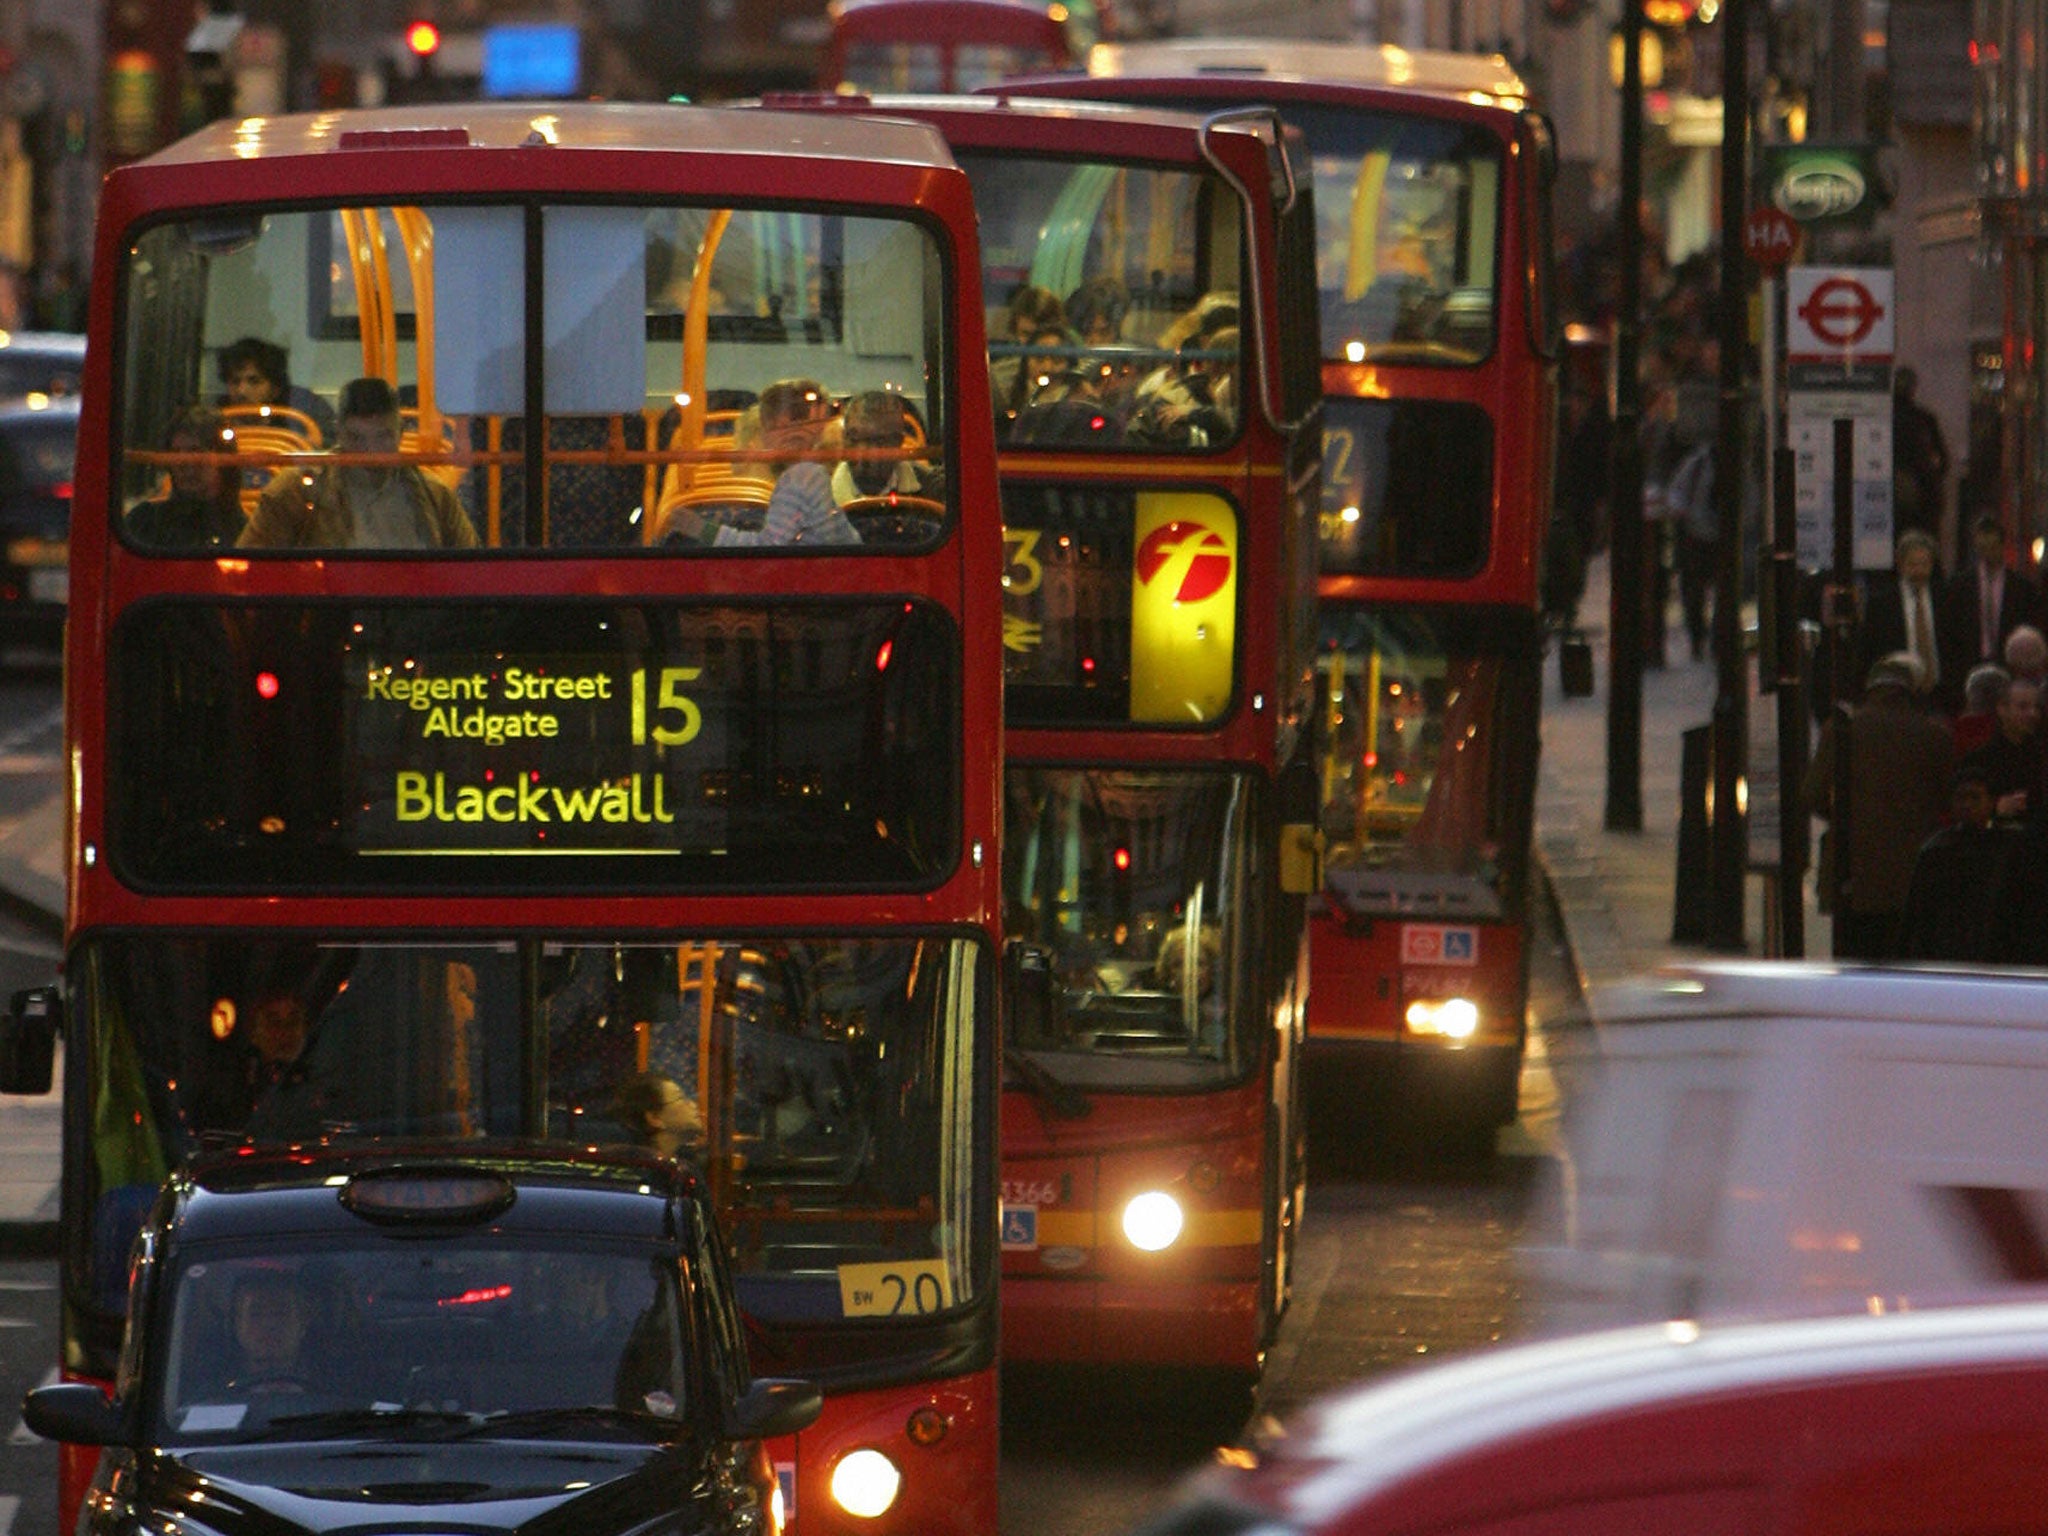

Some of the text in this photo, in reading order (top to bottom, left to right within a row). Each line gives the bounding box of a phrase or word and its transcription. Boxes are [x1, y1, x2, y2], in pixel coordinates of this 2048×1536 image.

[367, 667, 612, 710] Regent Street
[631, 667, 702, 746] 15
[422, 706, 559, 746] Aldgate
[395, 770, 675, 823] Blackwall
[881, 1272, 943, 1316] 20
